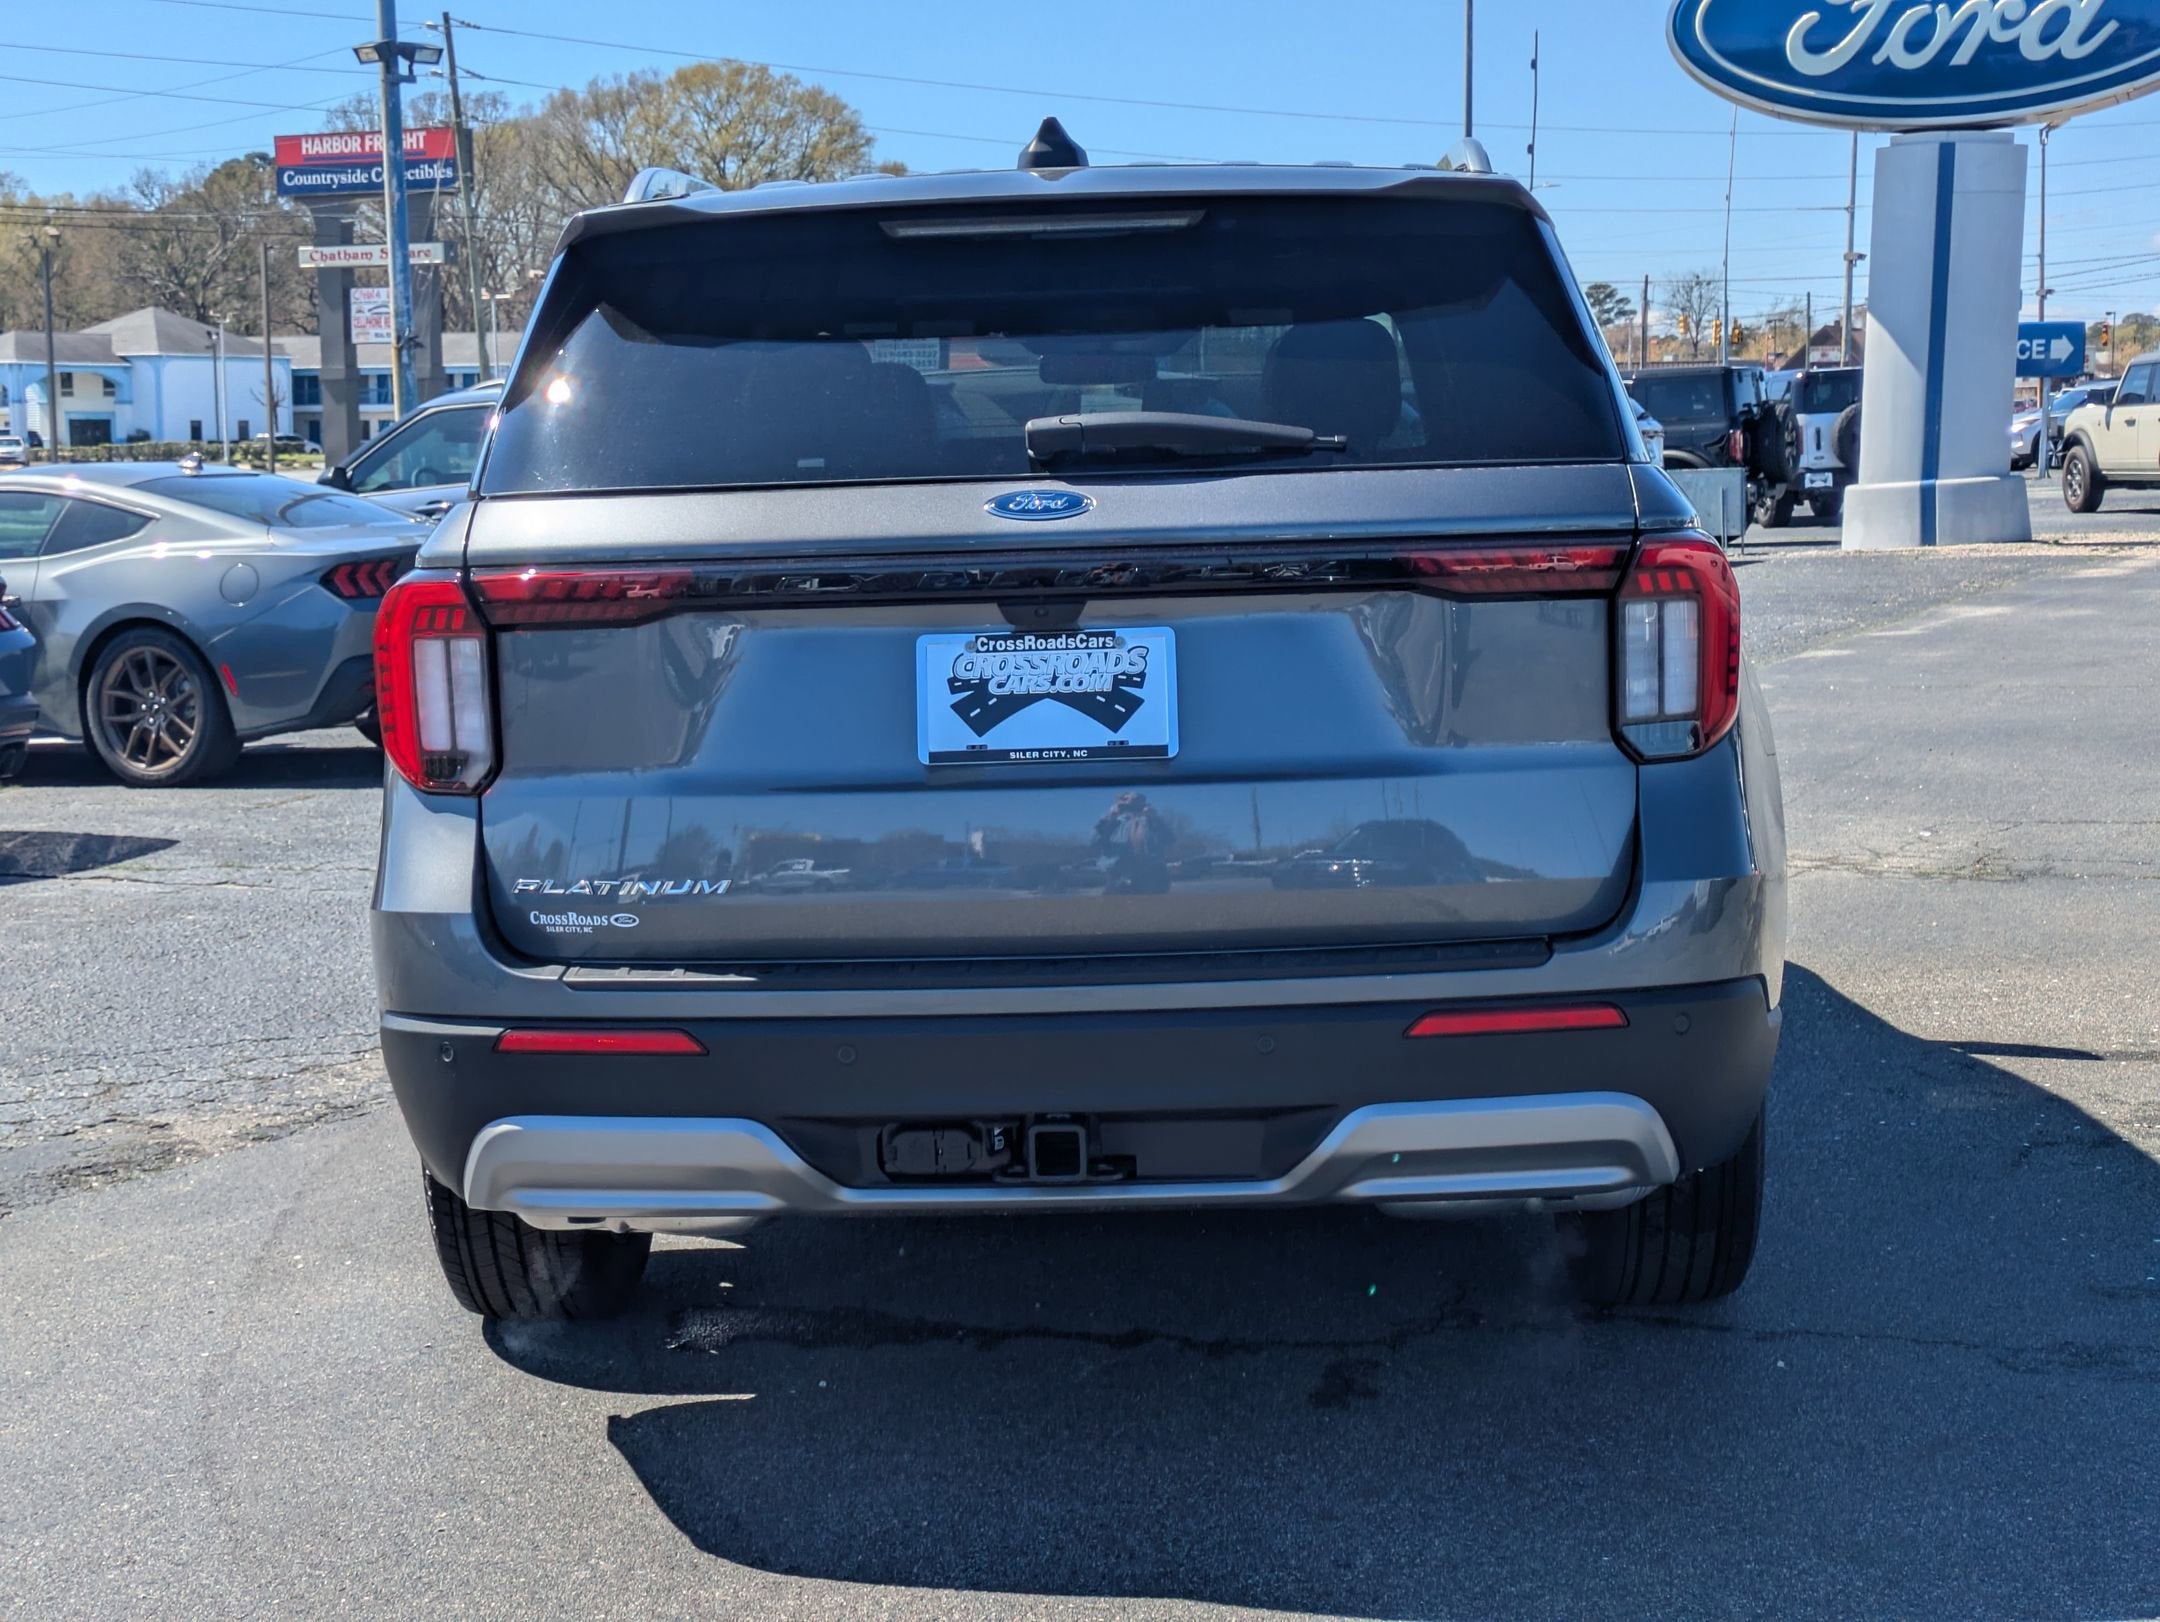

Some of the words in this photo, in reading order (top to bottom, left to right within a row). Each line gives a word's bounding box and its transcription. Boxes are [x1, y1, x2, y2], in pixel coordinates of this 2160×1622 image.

[301, 135, 361, 155] HARBOR
[365, 131, 426, 152] FRHT
[283, 168, 369, 188] Countryside
[371, 164, 453, 183] Cctibles
[309, 250, 373, 263] Chatham
[379, 247, 432, 260] Sare
[1009, 493, 1069, 510] Ford
[976, 635, 1114, 652] CrossRoadsCars
[952, 647, 1149, 680] CROSSROADS
[987, 674, 1114, 695] CARS.COM
[1009, 751, 1039, 759] SILER
[1042, 749, 1071, 760] CITY,
[1073, 749, 1088, 758] NC
[511, 878, 733, 896] PLATINUM
[546, 925, 564, 933] SILER
